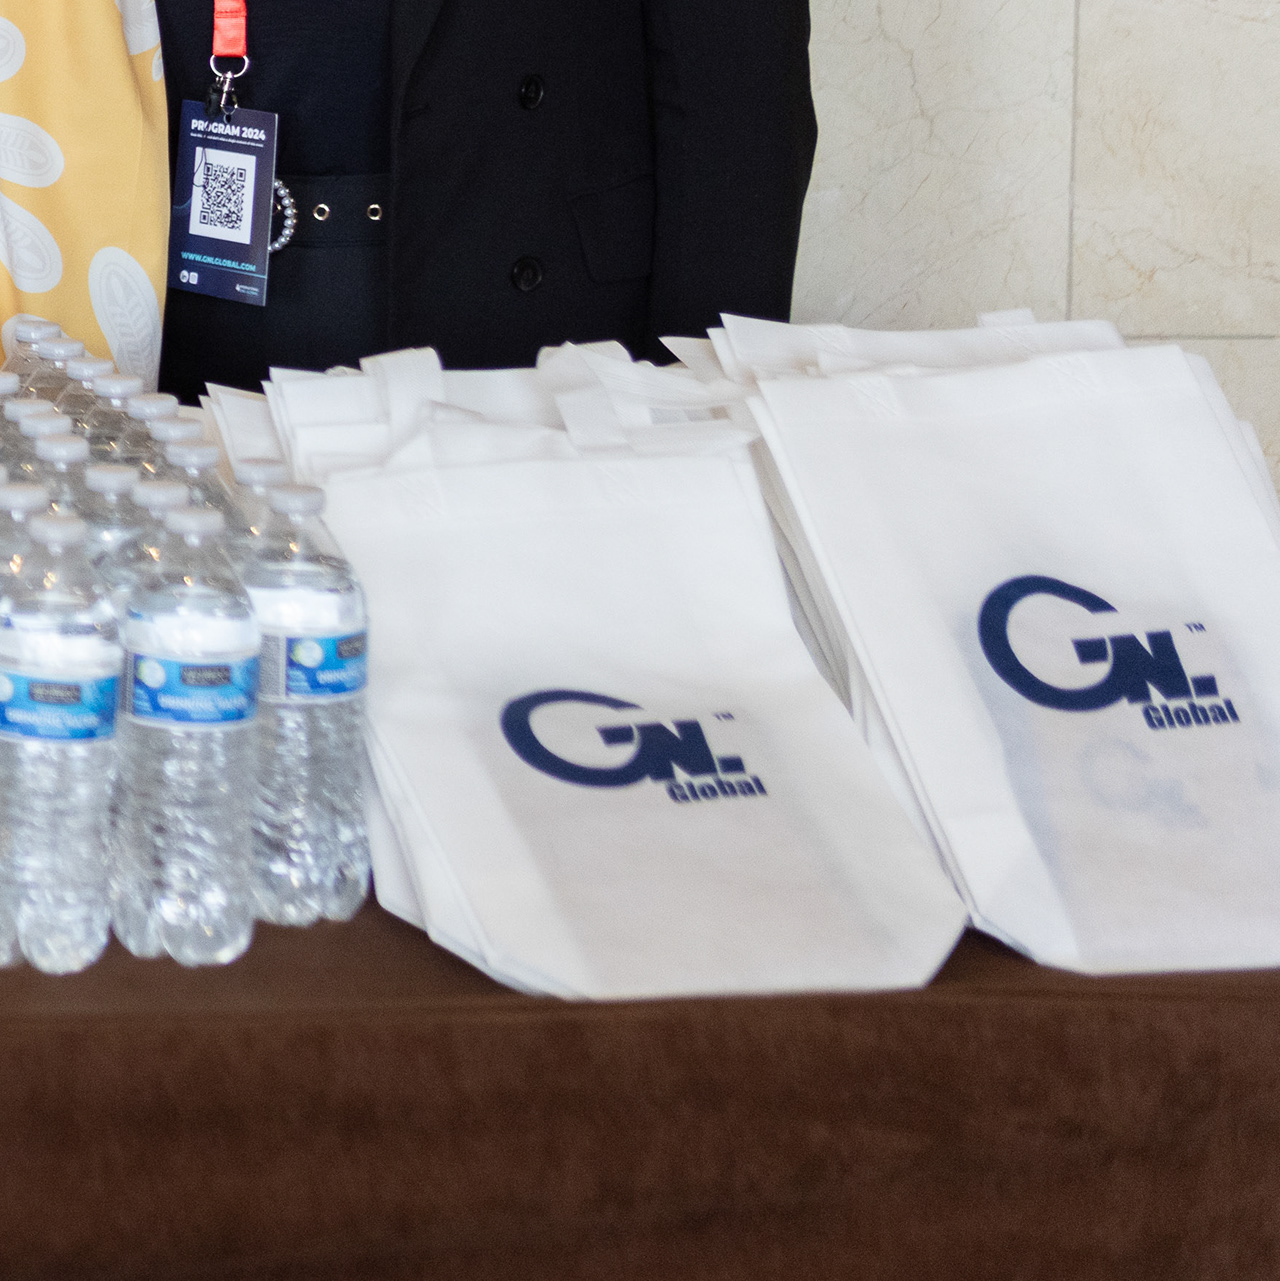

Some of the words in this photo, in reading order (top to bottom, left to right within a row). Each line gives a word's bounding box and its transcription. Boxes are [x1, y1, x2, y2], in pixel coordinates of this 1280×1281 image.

[241, 126, 266, 141] 2024
[1142, 697, 1241, 731] Global
[665, 774, 769, 804] Global
